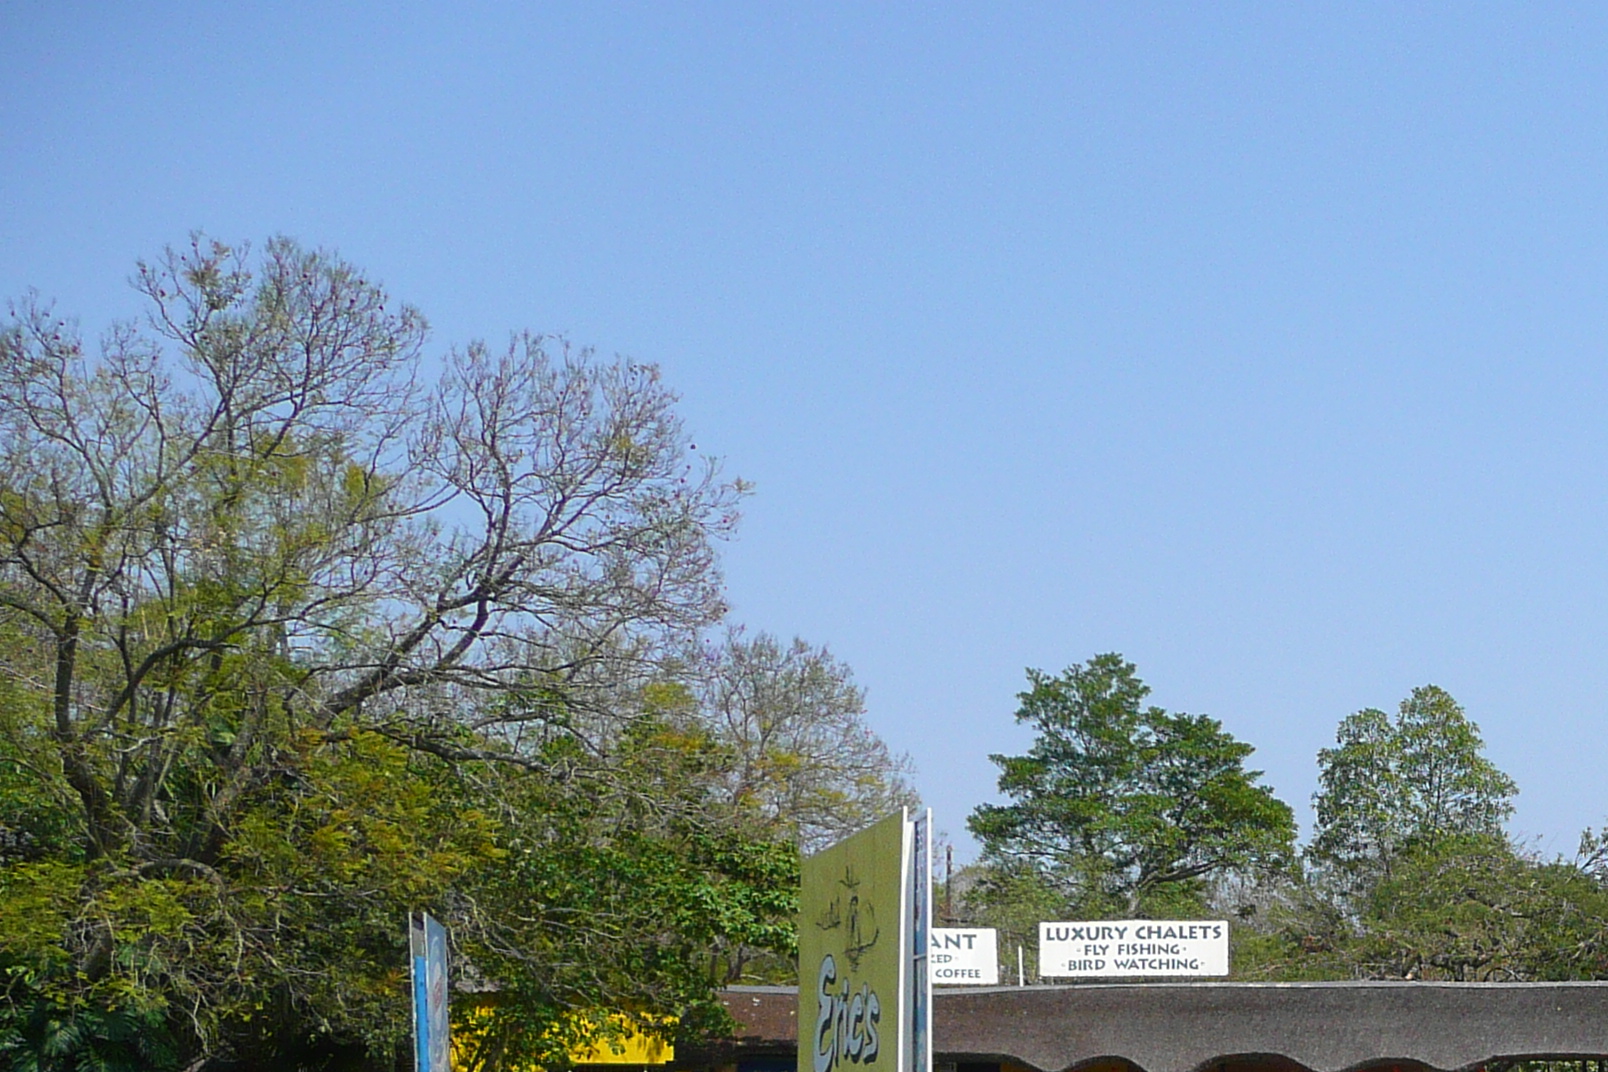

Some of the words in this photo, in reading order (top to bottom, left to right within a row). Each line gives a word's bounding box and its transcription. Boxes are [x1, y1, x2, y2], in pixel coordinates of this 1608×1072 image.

[1046, 926, 1128, 941] LUXURY
[1135, 925, 1222, 940] CHALETS
[1084, 944, 1109, 956] FLY
[1117, 943, 1180, 955] FISHING
[1068, 959, 1106, 971] BIRD
[1114, 958, 1199, 970] WATCHING
[935, 968, 981, 978] COFFEE
